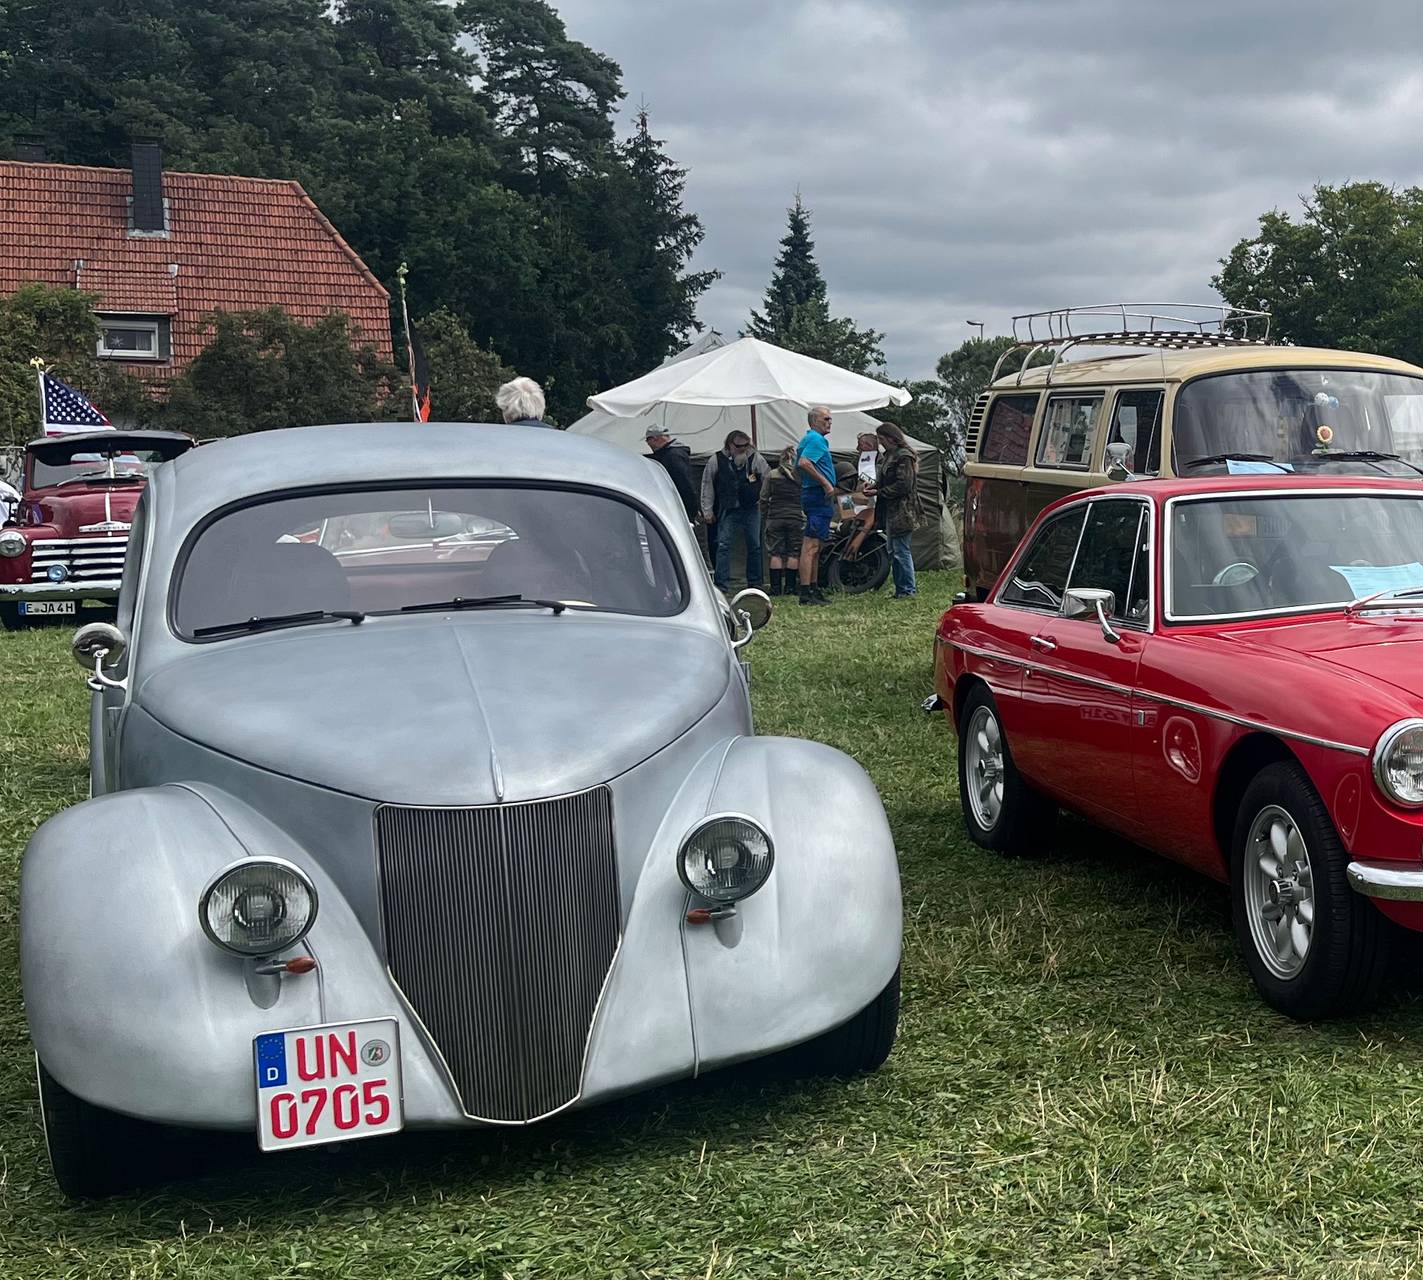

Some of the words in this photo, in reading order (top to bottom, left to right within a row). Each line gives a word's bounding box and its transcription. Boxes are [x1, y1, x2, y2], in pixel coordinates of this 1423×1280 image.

[26, 603, 33, 613] E
[267, 1067, 279, 1081] D
[296, 1030, 358, 1082] UN
[270, 1079, 390, 1139] 0705
